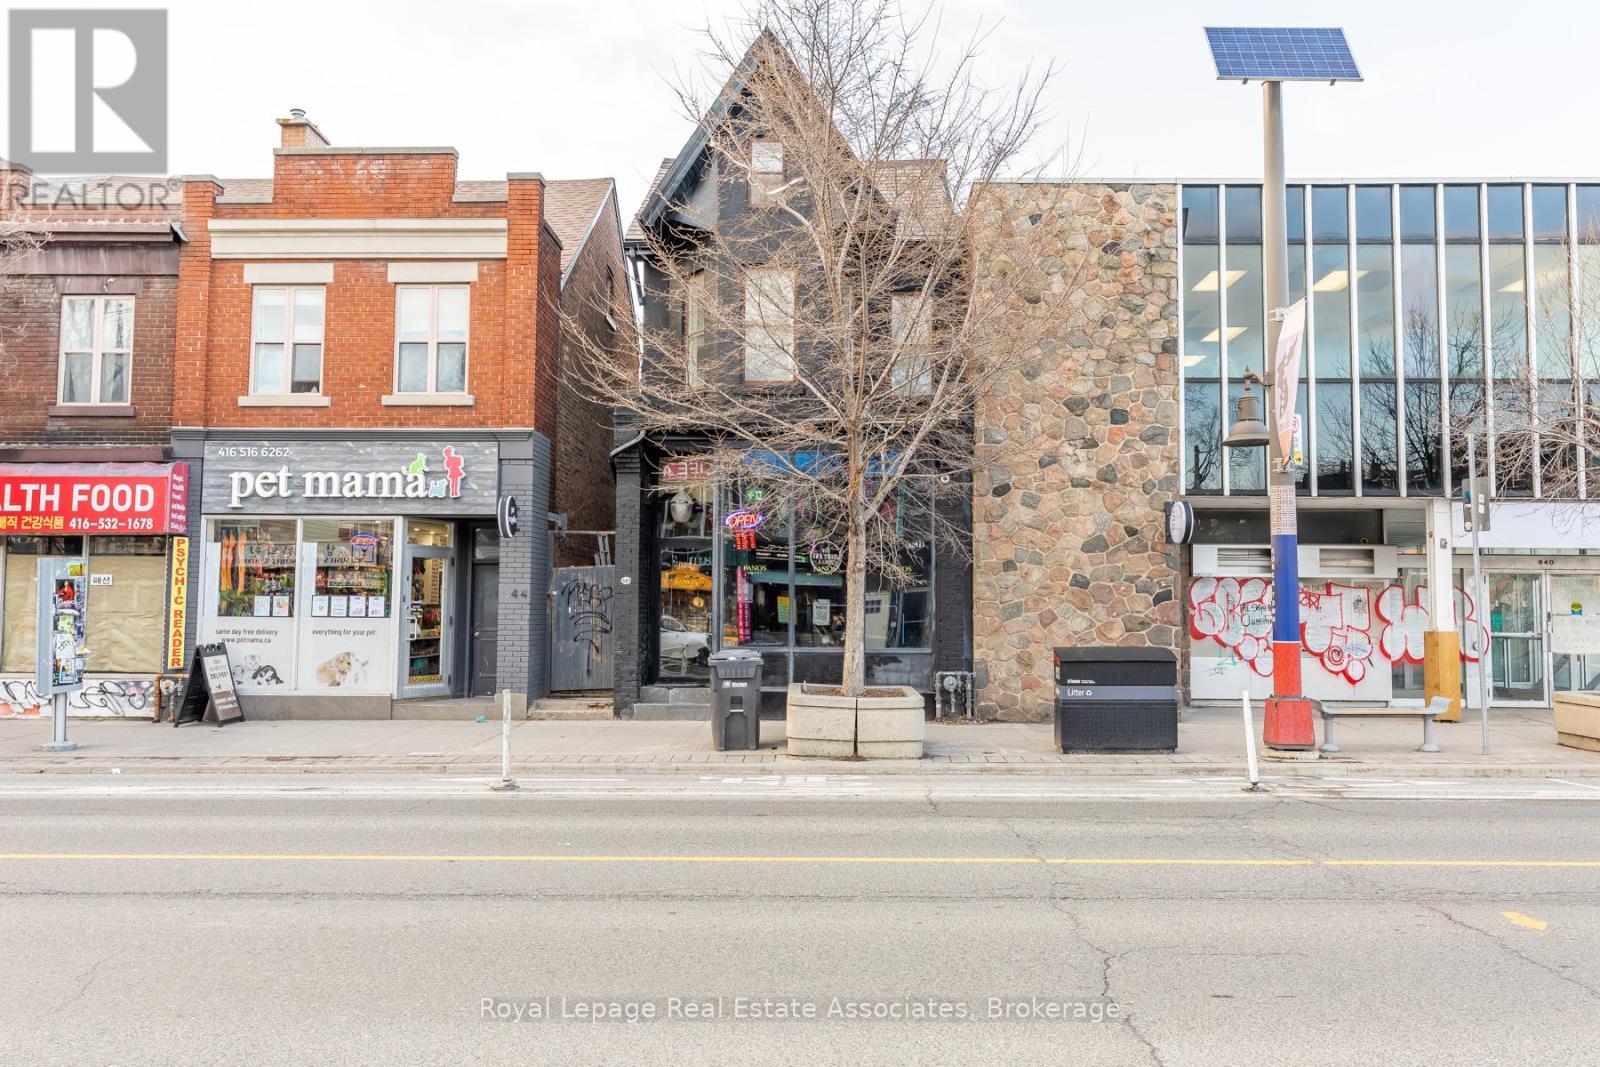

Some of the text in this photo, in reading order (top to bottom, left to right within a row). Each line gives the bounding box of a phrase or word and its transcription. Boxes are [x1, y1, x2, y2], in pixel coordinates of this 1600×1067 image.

[218, 447, 290, 457] 416 516 6262
[228, 465, 429, 508] pet mama
[0, 484, 154, 512] LTH FOOD
[69, 518, 154, 530] 416-532-1678
[728, 513, 760, 527] OPEN
[174, 538, 186, 605] PSYCHIC
[171, 609, 184, 667] READER
[1067, 687, 1085, 697] Litter
